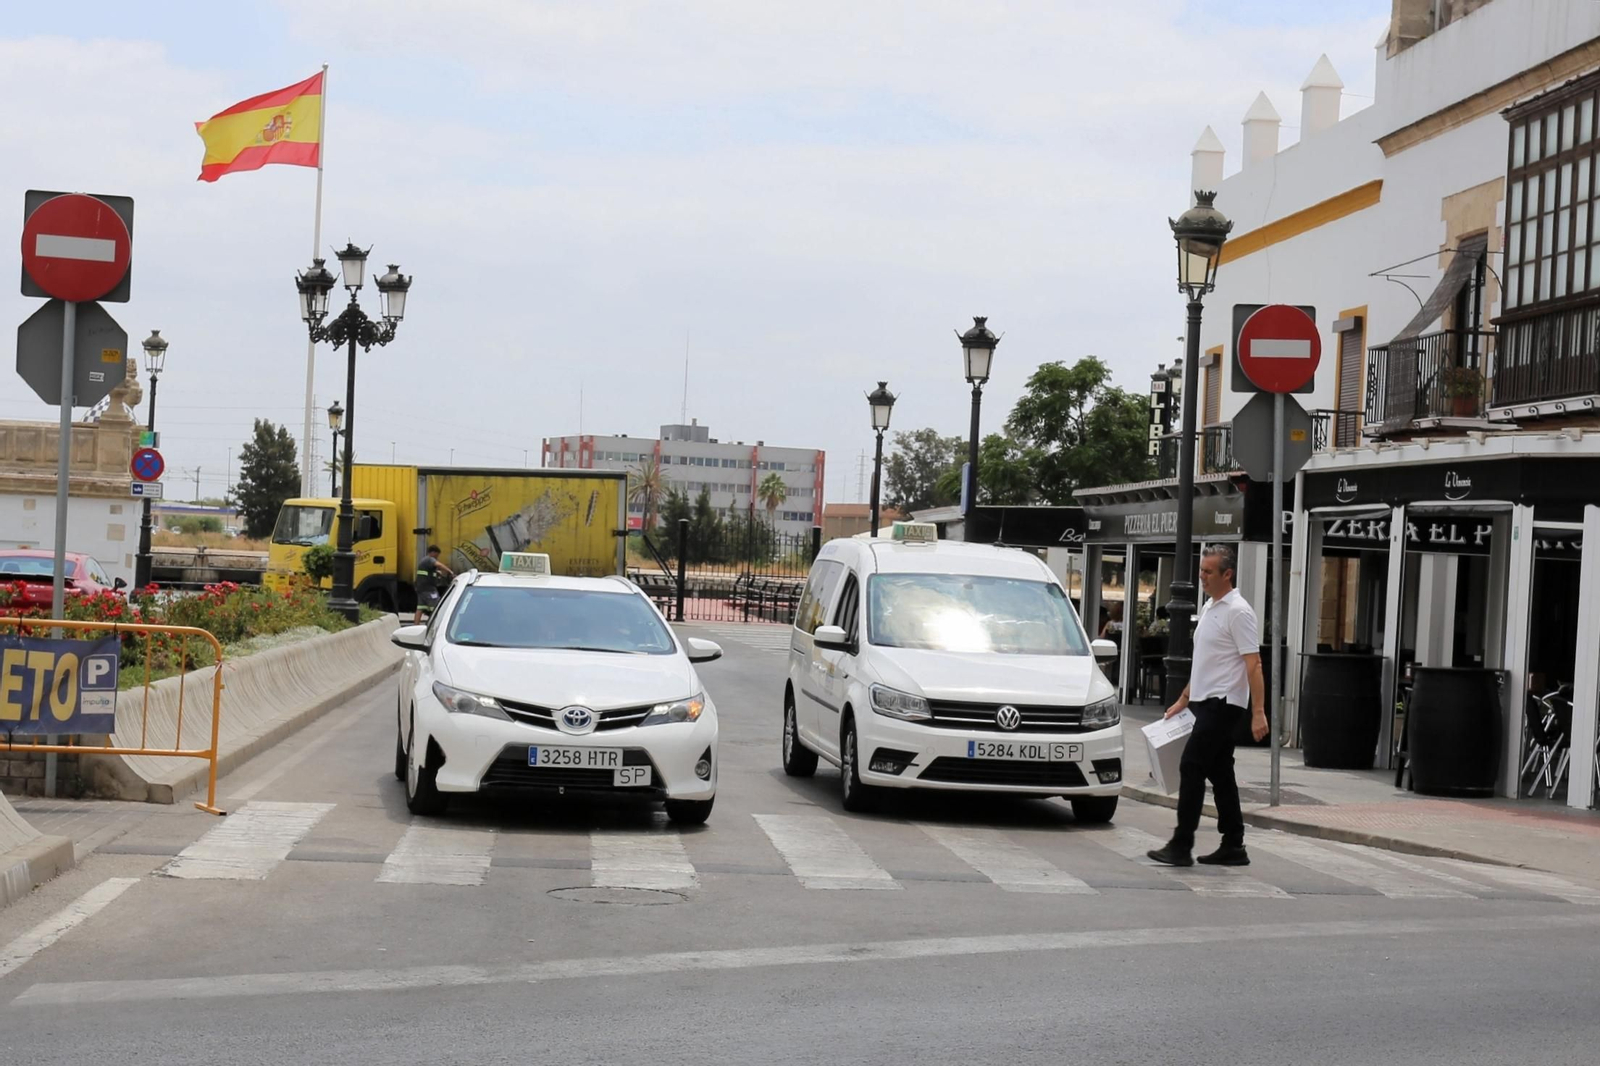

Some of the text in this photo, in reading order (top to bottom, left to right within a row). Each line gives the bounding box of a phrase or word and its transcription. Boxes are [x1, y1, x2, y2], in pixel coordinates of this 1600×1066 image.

[902, 525, 925, 537] TAXI
[1124, 511, 1178, 535] PIZZERIA EL PUER
[1429, 523, 1466, 544] EL
[511, 556, 535, 568] TAXI
[87, 659, 110, 685] P
[541, 749, 618, 766] 3258 HTR
[977, 743, 1014, 757] 5284
[1019, 745, 1046, 759] KDL
